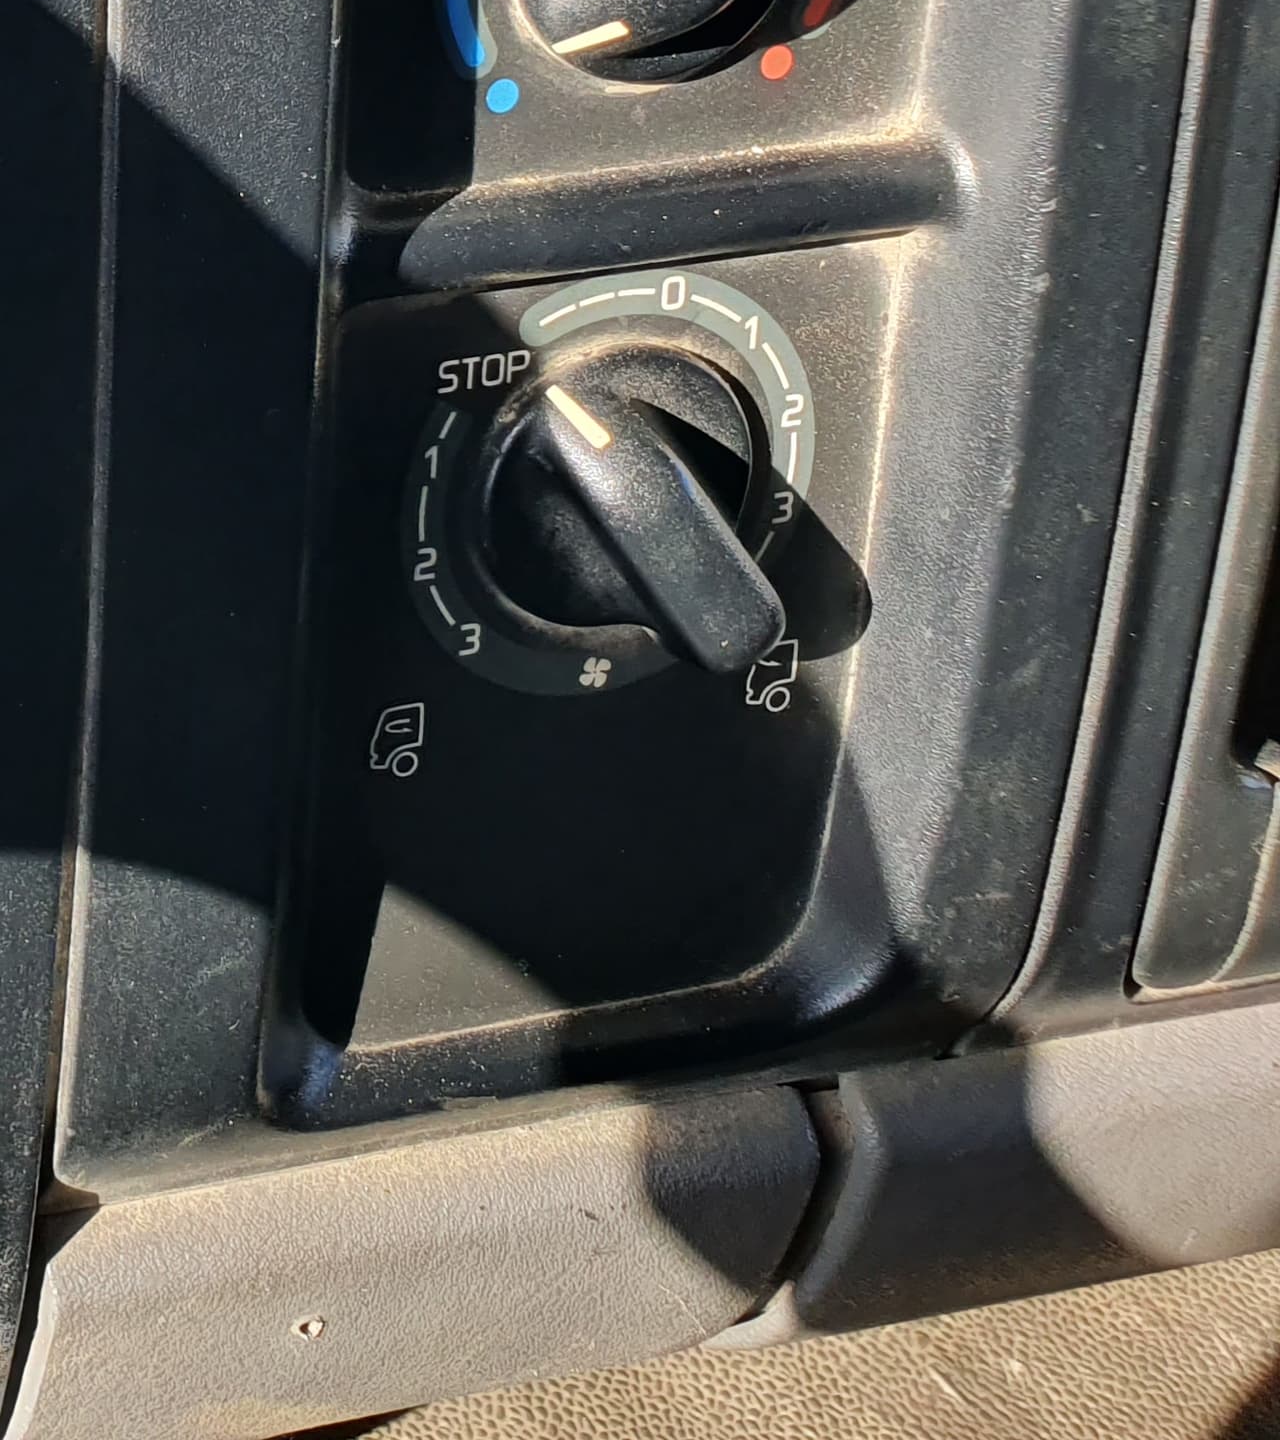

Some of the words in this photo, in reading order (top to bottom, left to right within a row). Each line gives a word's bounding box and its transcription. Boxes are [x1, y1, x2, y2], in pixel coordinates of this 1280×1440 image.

[742, 315, 760, 350] 1
[437, 349, 531, 394] STOP
[781, 393, 804, 428] 2
[424, 443, 440, 479] 1
[771, 490, 795, 525] 3
[413, 547, 438, 582] 2
[457, 623, 481, 656] 3
